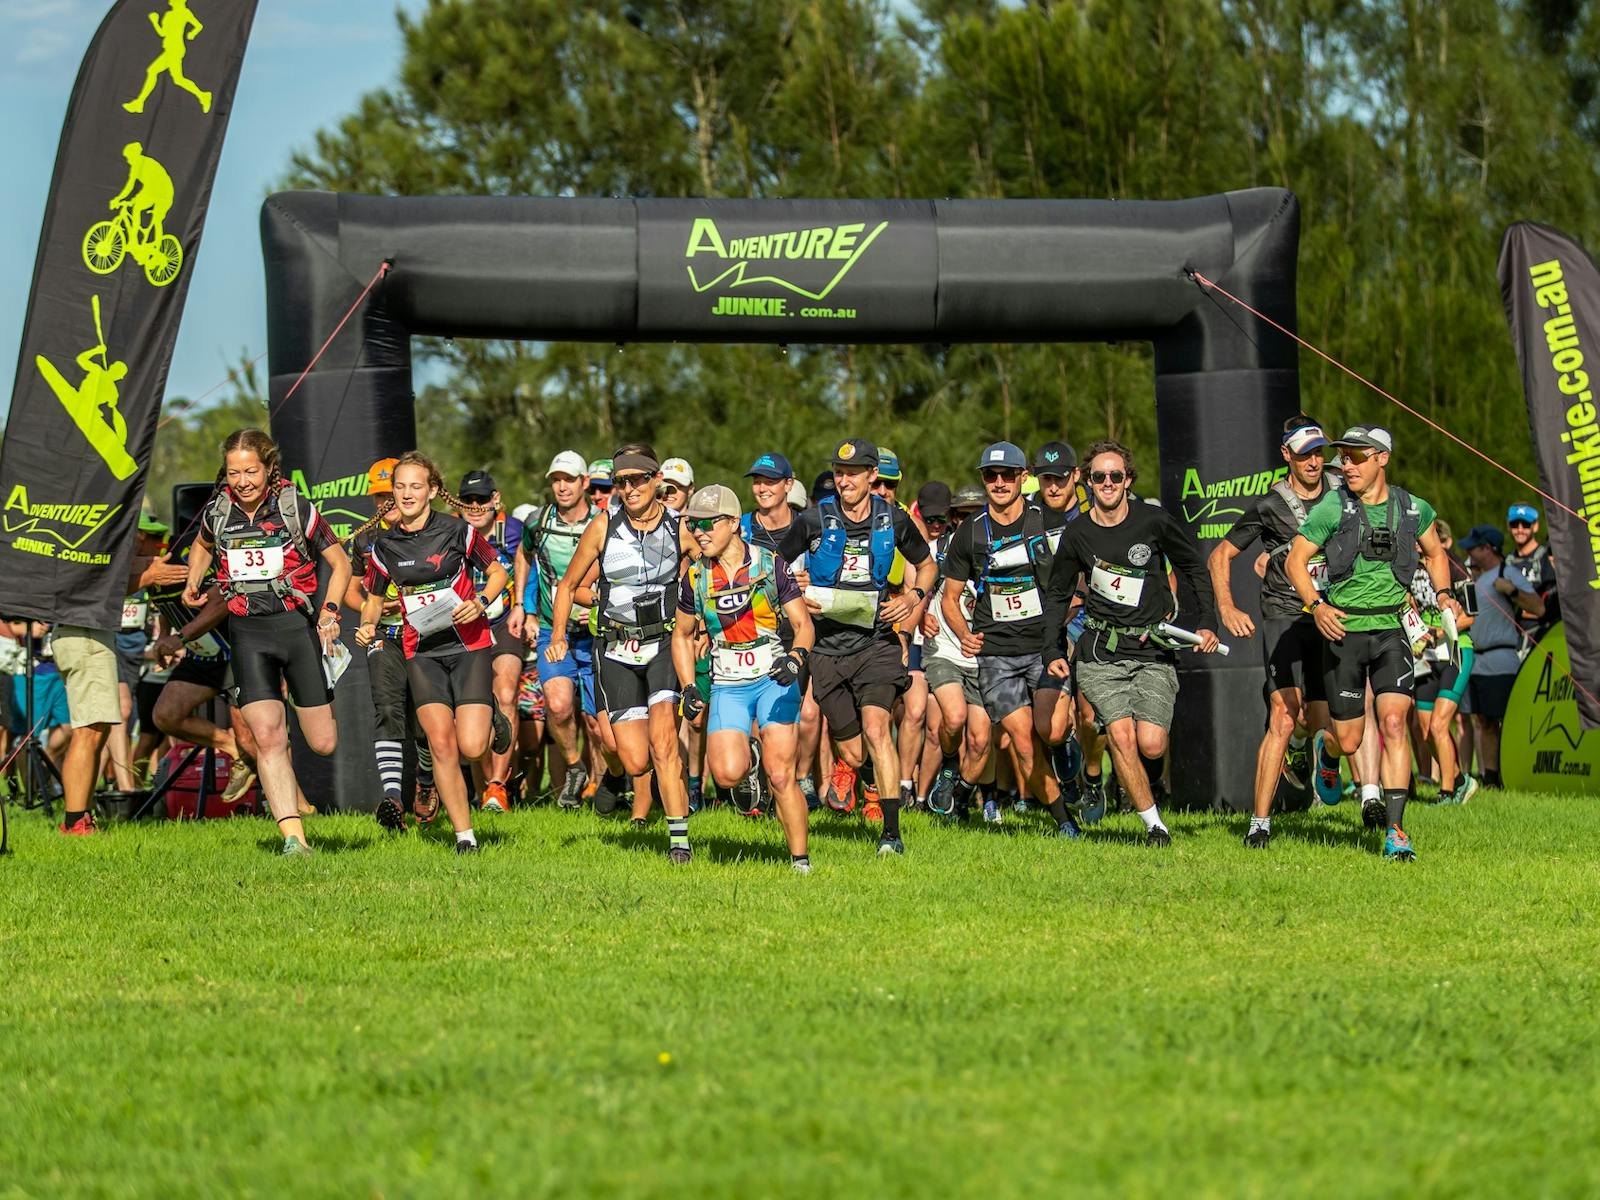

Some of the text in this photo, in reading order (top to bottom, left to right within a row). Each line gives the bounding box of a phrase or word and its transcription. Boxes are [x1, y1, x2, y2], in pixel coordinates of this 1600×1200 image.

[685, 217, 866, 260] ADVENTURE
[4, 484, 109, 528] ADVENTURE
[244, 550, 265, 567] 33
[1310, 563, 1328, 579] 47
[1110, 576, 1121, 591] 4
[718, 593, 748, 608] GU
[1005, 595, 1022, 611] 15
[1407, 607, 1420, 629] 47
[735, 651, 755, 667] 70
